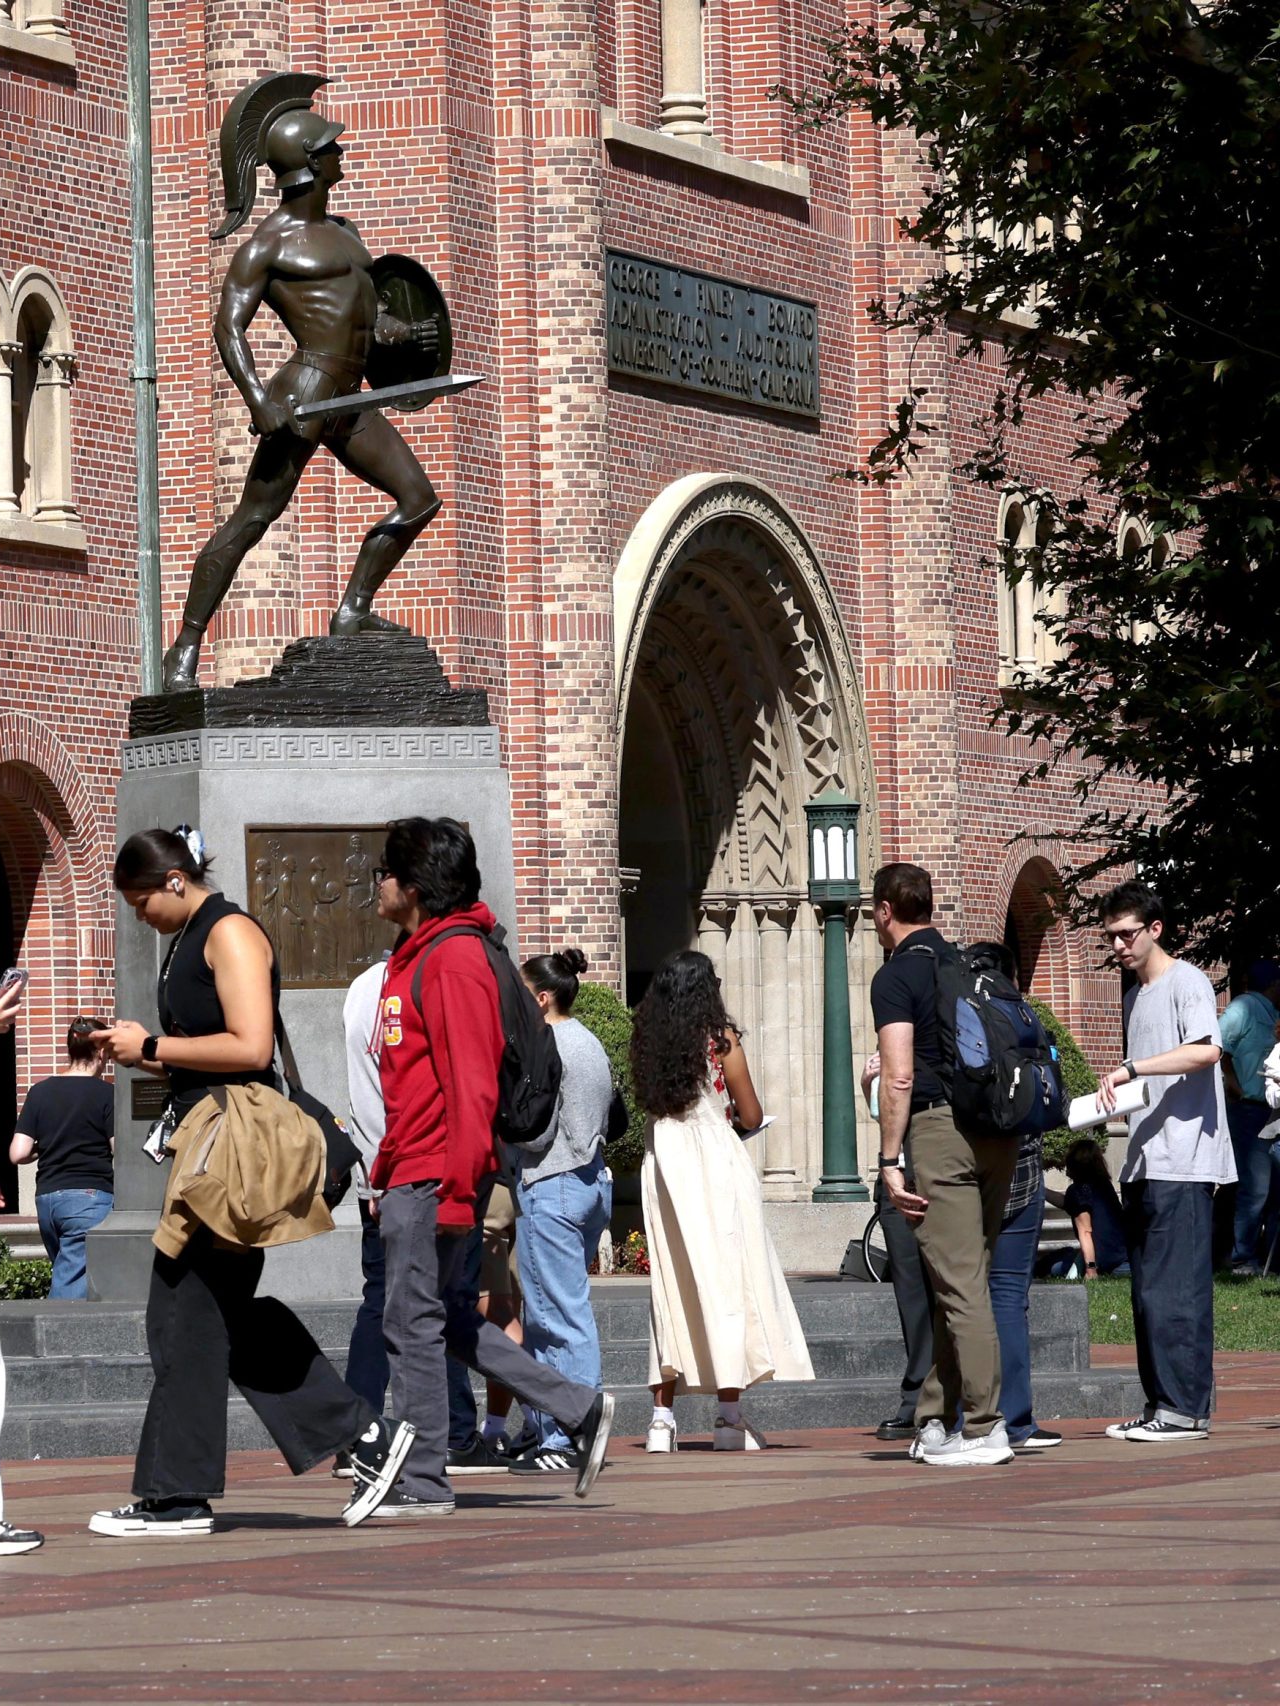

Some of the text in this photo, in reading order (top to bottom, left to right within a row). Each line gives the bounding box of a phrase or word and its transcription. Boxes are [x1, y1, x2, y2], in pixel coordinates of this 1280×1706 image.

[610, 259, 814, 341] GEORGE FINLEY BOVARD
[610, 296, 815, 376] ADMINISTRATION AUDITORIUM
[611, 332, 816, 411] UNIVERSITY OF SOUTHERN CALIFORNIA
[960, 1437, 985, 1451] HOKA
